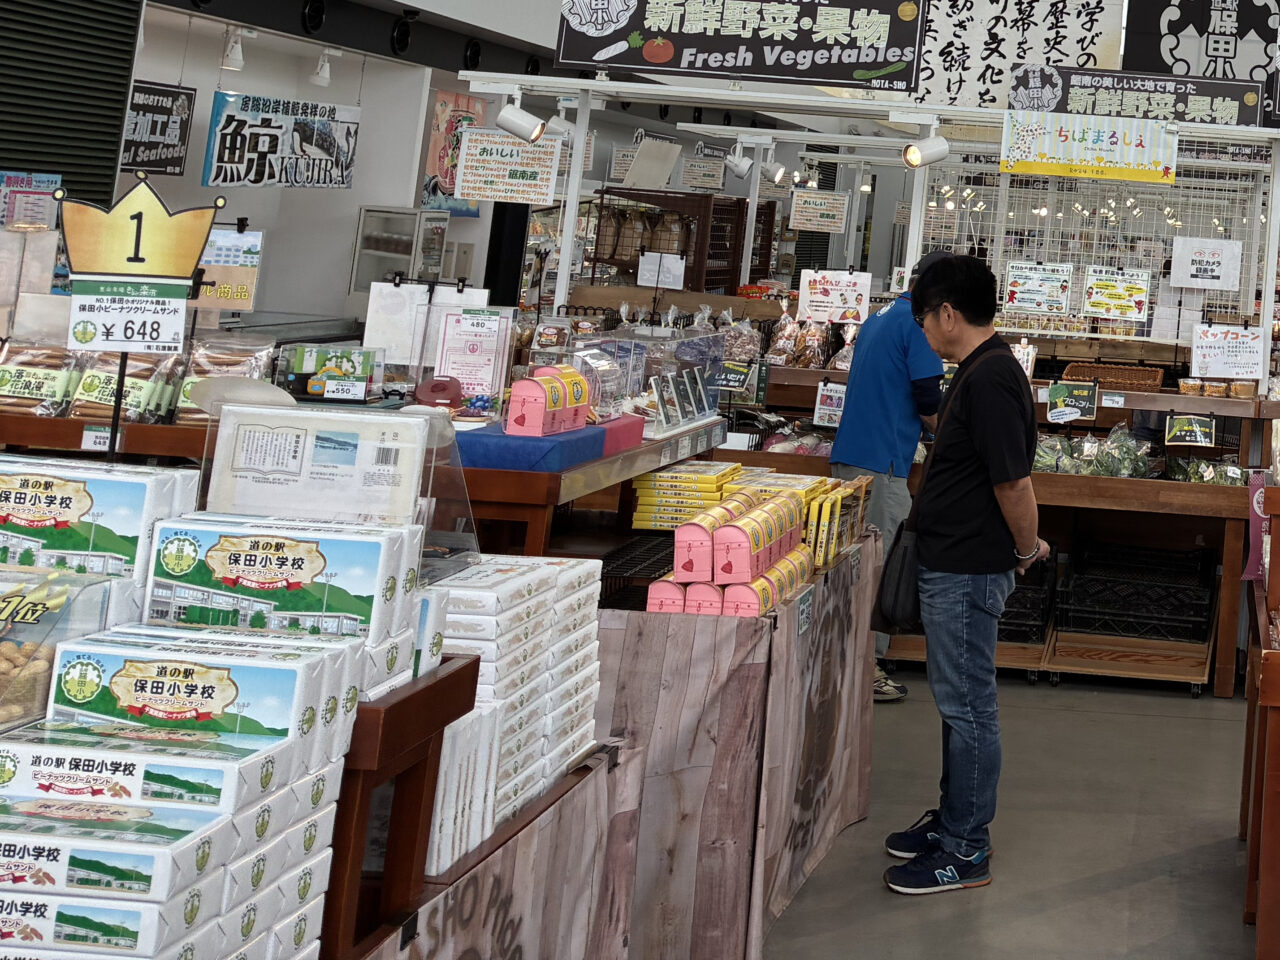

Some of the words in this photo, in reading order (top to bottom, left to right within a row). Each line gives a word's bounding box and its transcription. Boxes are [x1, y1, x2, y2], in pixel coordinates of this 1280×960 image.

[681, 48, 753, 68] Fresh
[764, 43, 915, 69] Vegetables
[1067, 87, 1240, 125] 新鮮野菜・果物
[212, 115, 284, 184] 鯨
[479, 147, 519, 158] おいしい
[276, 156, 347, 186] KUJIRA
[126, 211, 146, 263] 1
[123, 321, 161, 340] 648
[19, 478, 54, 491] 道の駅
[0, 491, 73, 510] 保田小学校
[249, 540, 286, 553] 道の駅
[228, 552, 305, 571] 保田小学校
[155, 666, 195, 680] 道の駅
[134, 678, 216, 700] 保田小学校
[31, 755, 65, 769] 道の駅
[69, 757, 137, 777] 保田小学校
[0, 900, 49, 918] 小学校
